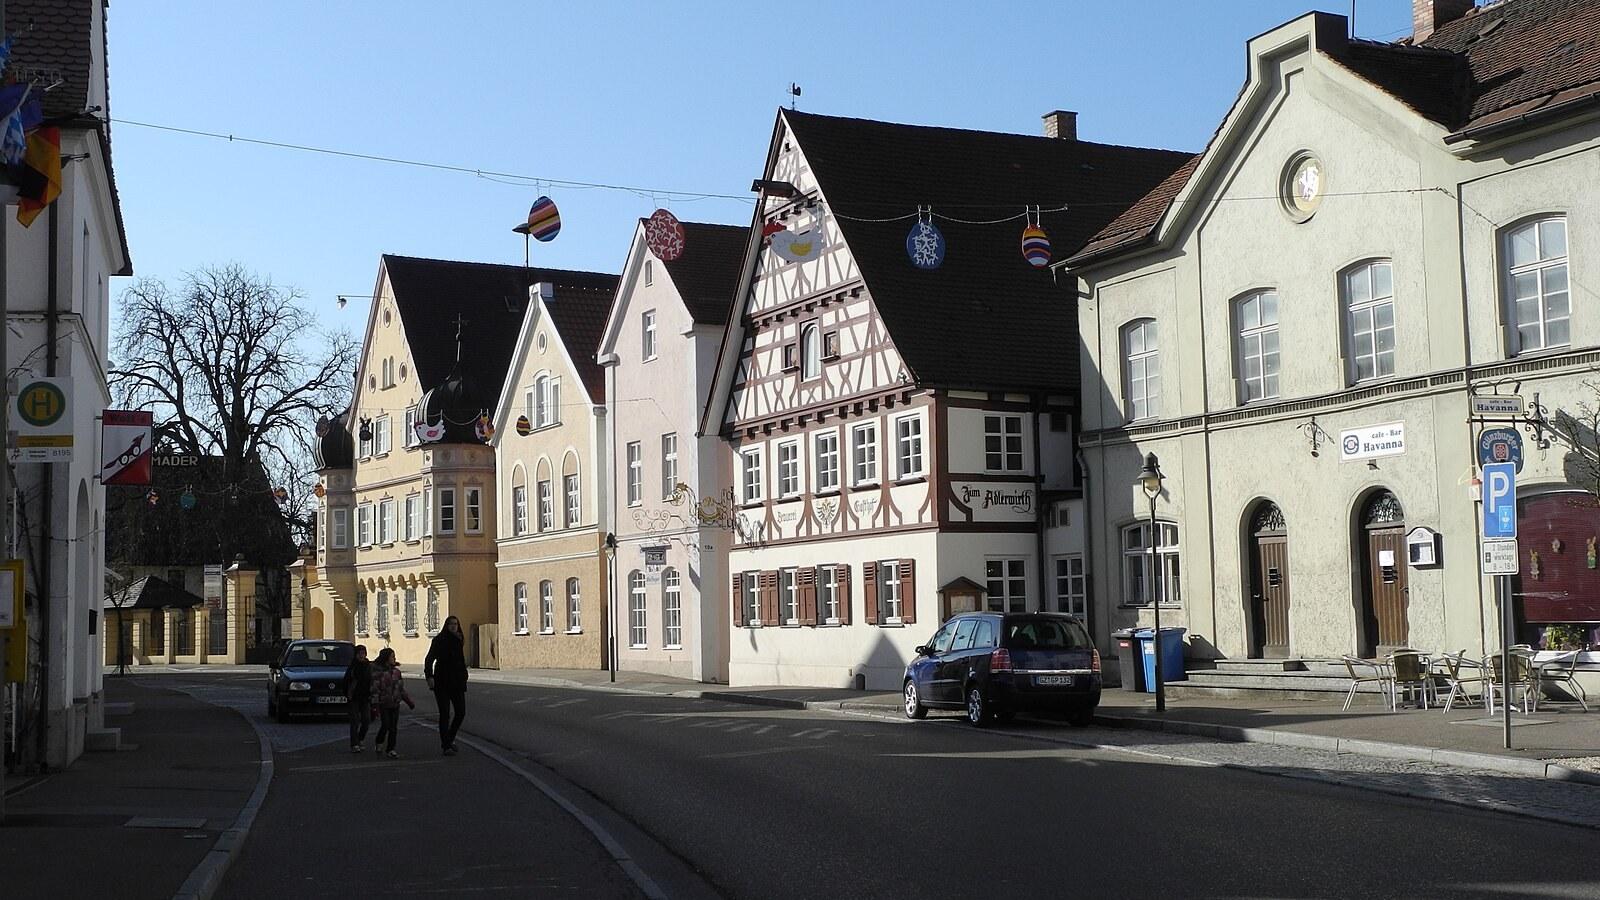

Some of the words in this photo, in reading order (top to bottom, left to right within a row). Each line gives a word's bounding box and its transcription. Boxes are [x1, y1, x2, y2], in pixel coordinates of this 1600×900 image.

[32, 391, 51, 416] H
[1363, 440, 1403, 452] Havanna
[961, 485, 981, 504] Zum
[982, 489, 1034, 514] Adlerwirth
[1489, 471, 1510, 513] P
